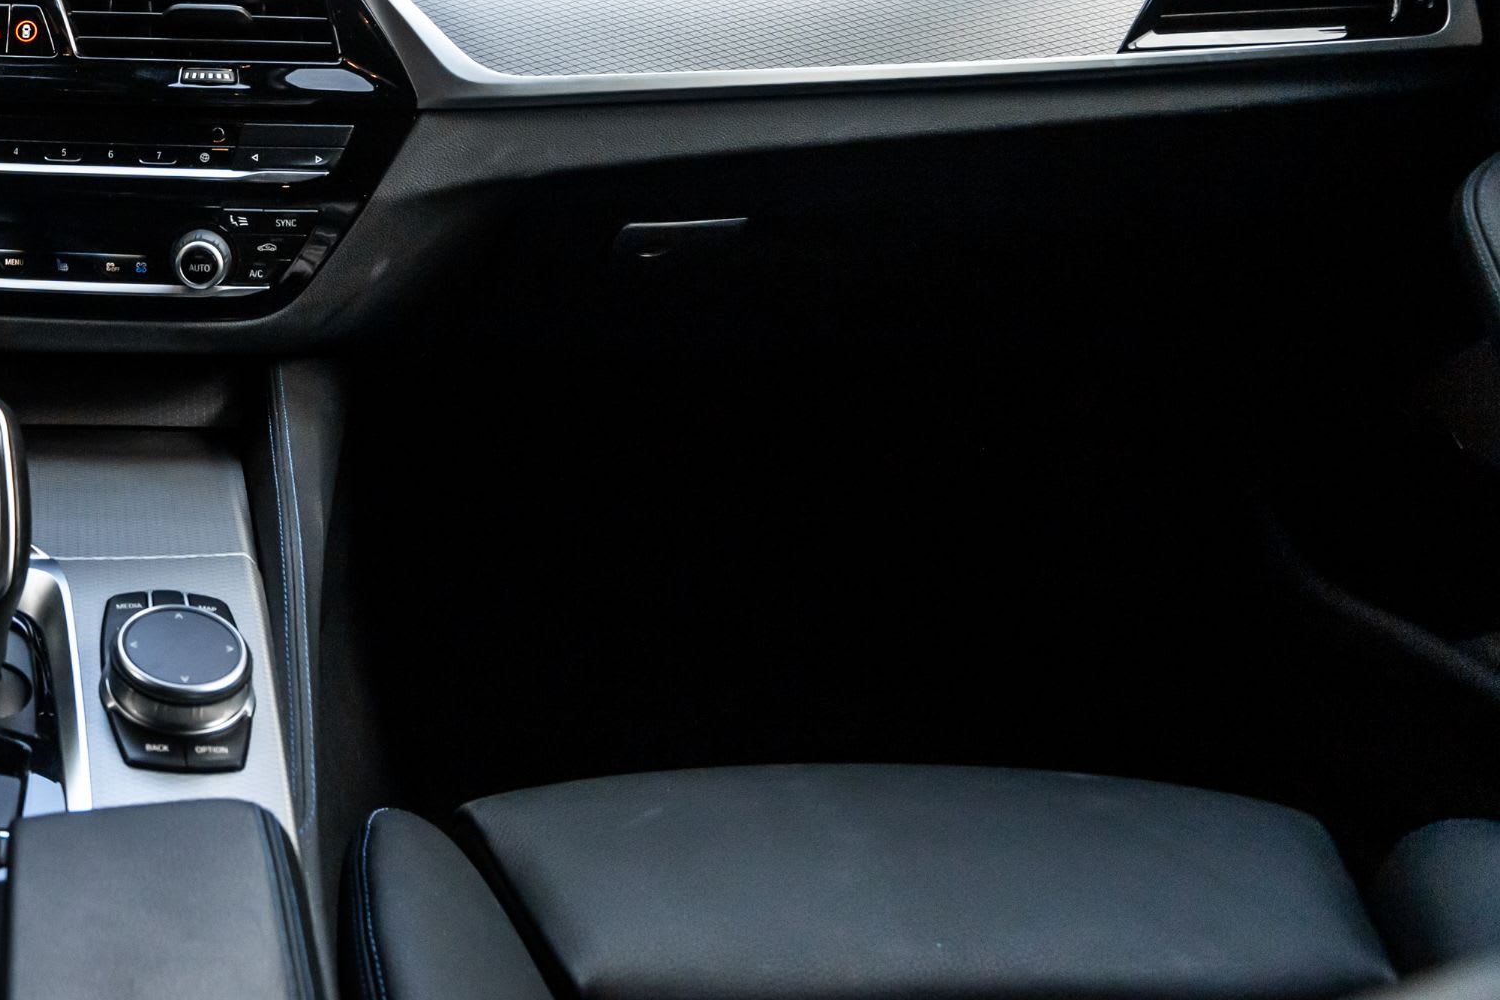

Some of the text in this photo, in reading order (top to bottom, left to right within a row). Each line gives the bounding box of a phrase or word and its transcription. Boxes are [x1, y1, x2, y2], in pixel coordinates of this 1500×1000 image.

[12, 147, 19, 155] 4
[61, 148, 67, 157] 5
[107, 150, 114, 159] 6
[156, 151, 162, 160] 7
[275, 218, 297, 228] SYNC
[4, 258, 24, 266] MENU
[188, 264, 211, 273] AUTO
[249, 269, 264, 278] A/C
[116, 602, 143, 610] MEDIA
[144, 743, 170, 753] BACK
[194, 745, 230, 755] OPTION
